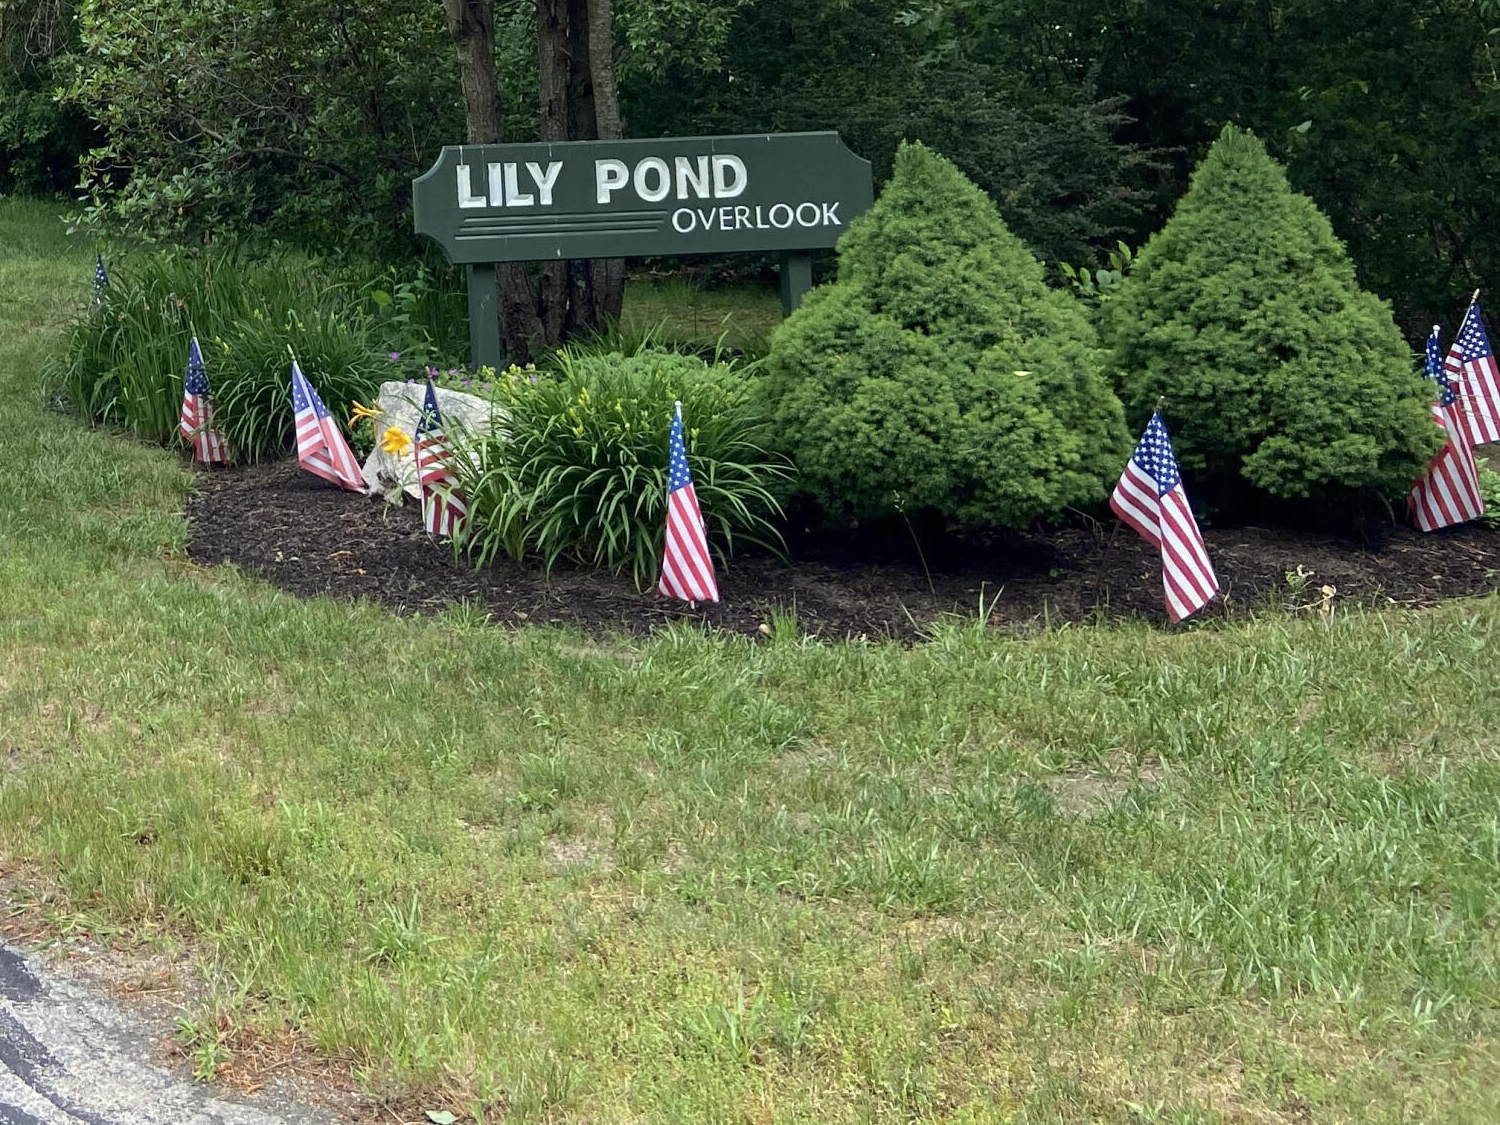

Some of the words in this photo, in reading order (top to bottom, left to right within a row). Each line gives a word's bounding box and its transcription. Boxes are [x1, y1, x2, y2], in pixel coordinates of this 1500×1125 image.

[456, 161, 563, 208] LILY
[595, 154, 748, 204] POND
[671, 201, 842, 233] OVERLOOK
